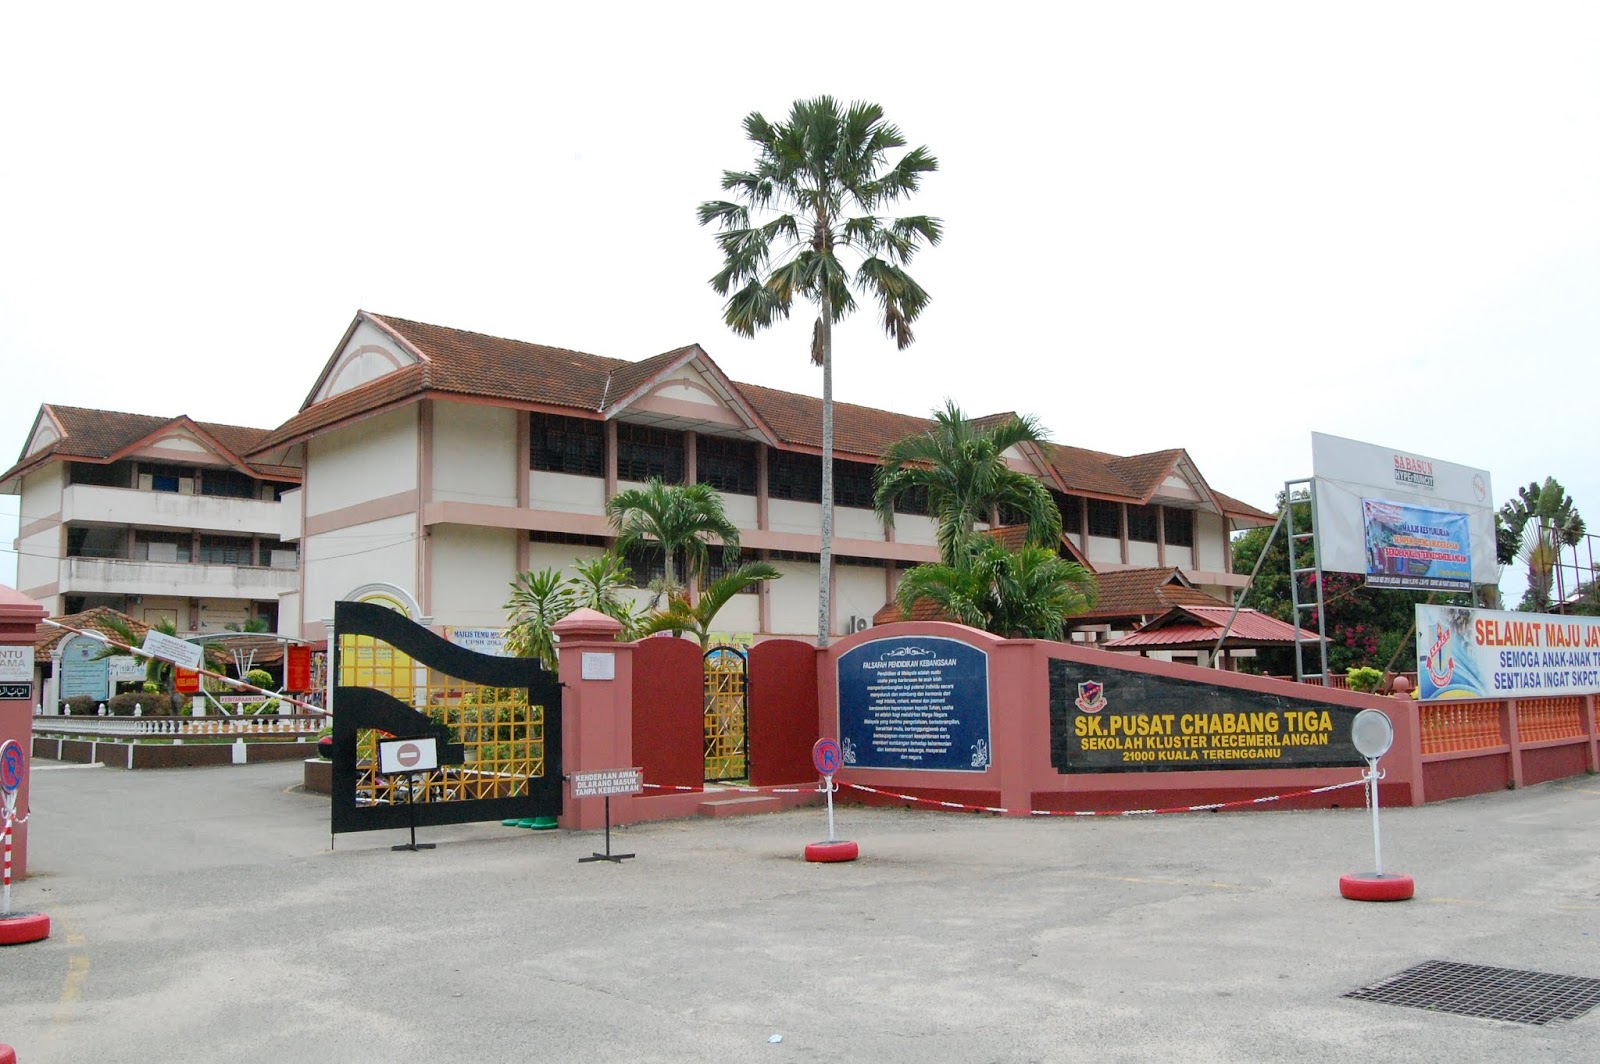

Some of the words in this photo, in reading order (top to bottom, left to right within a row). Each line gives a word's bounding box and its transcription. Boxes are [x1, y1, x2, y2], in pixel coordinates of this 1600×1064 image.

[1394, 455, 1432, 475] SABASUN
[1475, 619, 1541, 647] SELAMAT
[1546, 624, 1580, 647] MAJU
[863, 660, 887, 669] FALSAFAH
[888, 660, 918, 668] PENDIDIKAN
[920, 659, 956, 667] KEBANGSAAN
[1500, 651, 1540, 668] SEMOGA
[1543, 652, 1591, 667] ANAK-ANAK
[1494, 672, 1541, 689] SENTIASA
[1544, 672, 1569, 688] INGAT
[1180, 713, 1280, 734] CHABANG
[1284, 711, 1332, 732] TIGA
[1081, 735, 1143, 750] SEKOLAH
[1146, 735, 1208, 749] KLUSTER
[1211, 733, 1328, 748] KECEMERLANGAN
[1122, 752, 1155, 762] 21000
[1158, 750, 1198, 761] KUALA
[1202, 749, 1282, 760] TERENGGANU
[576, 772, 616, 782] KENDERAAN
[577, 780, 611, 789] DILARANG
[613, 778, 636, 786] MASUK
[598, 785, 639, 794] KEBENARAN
